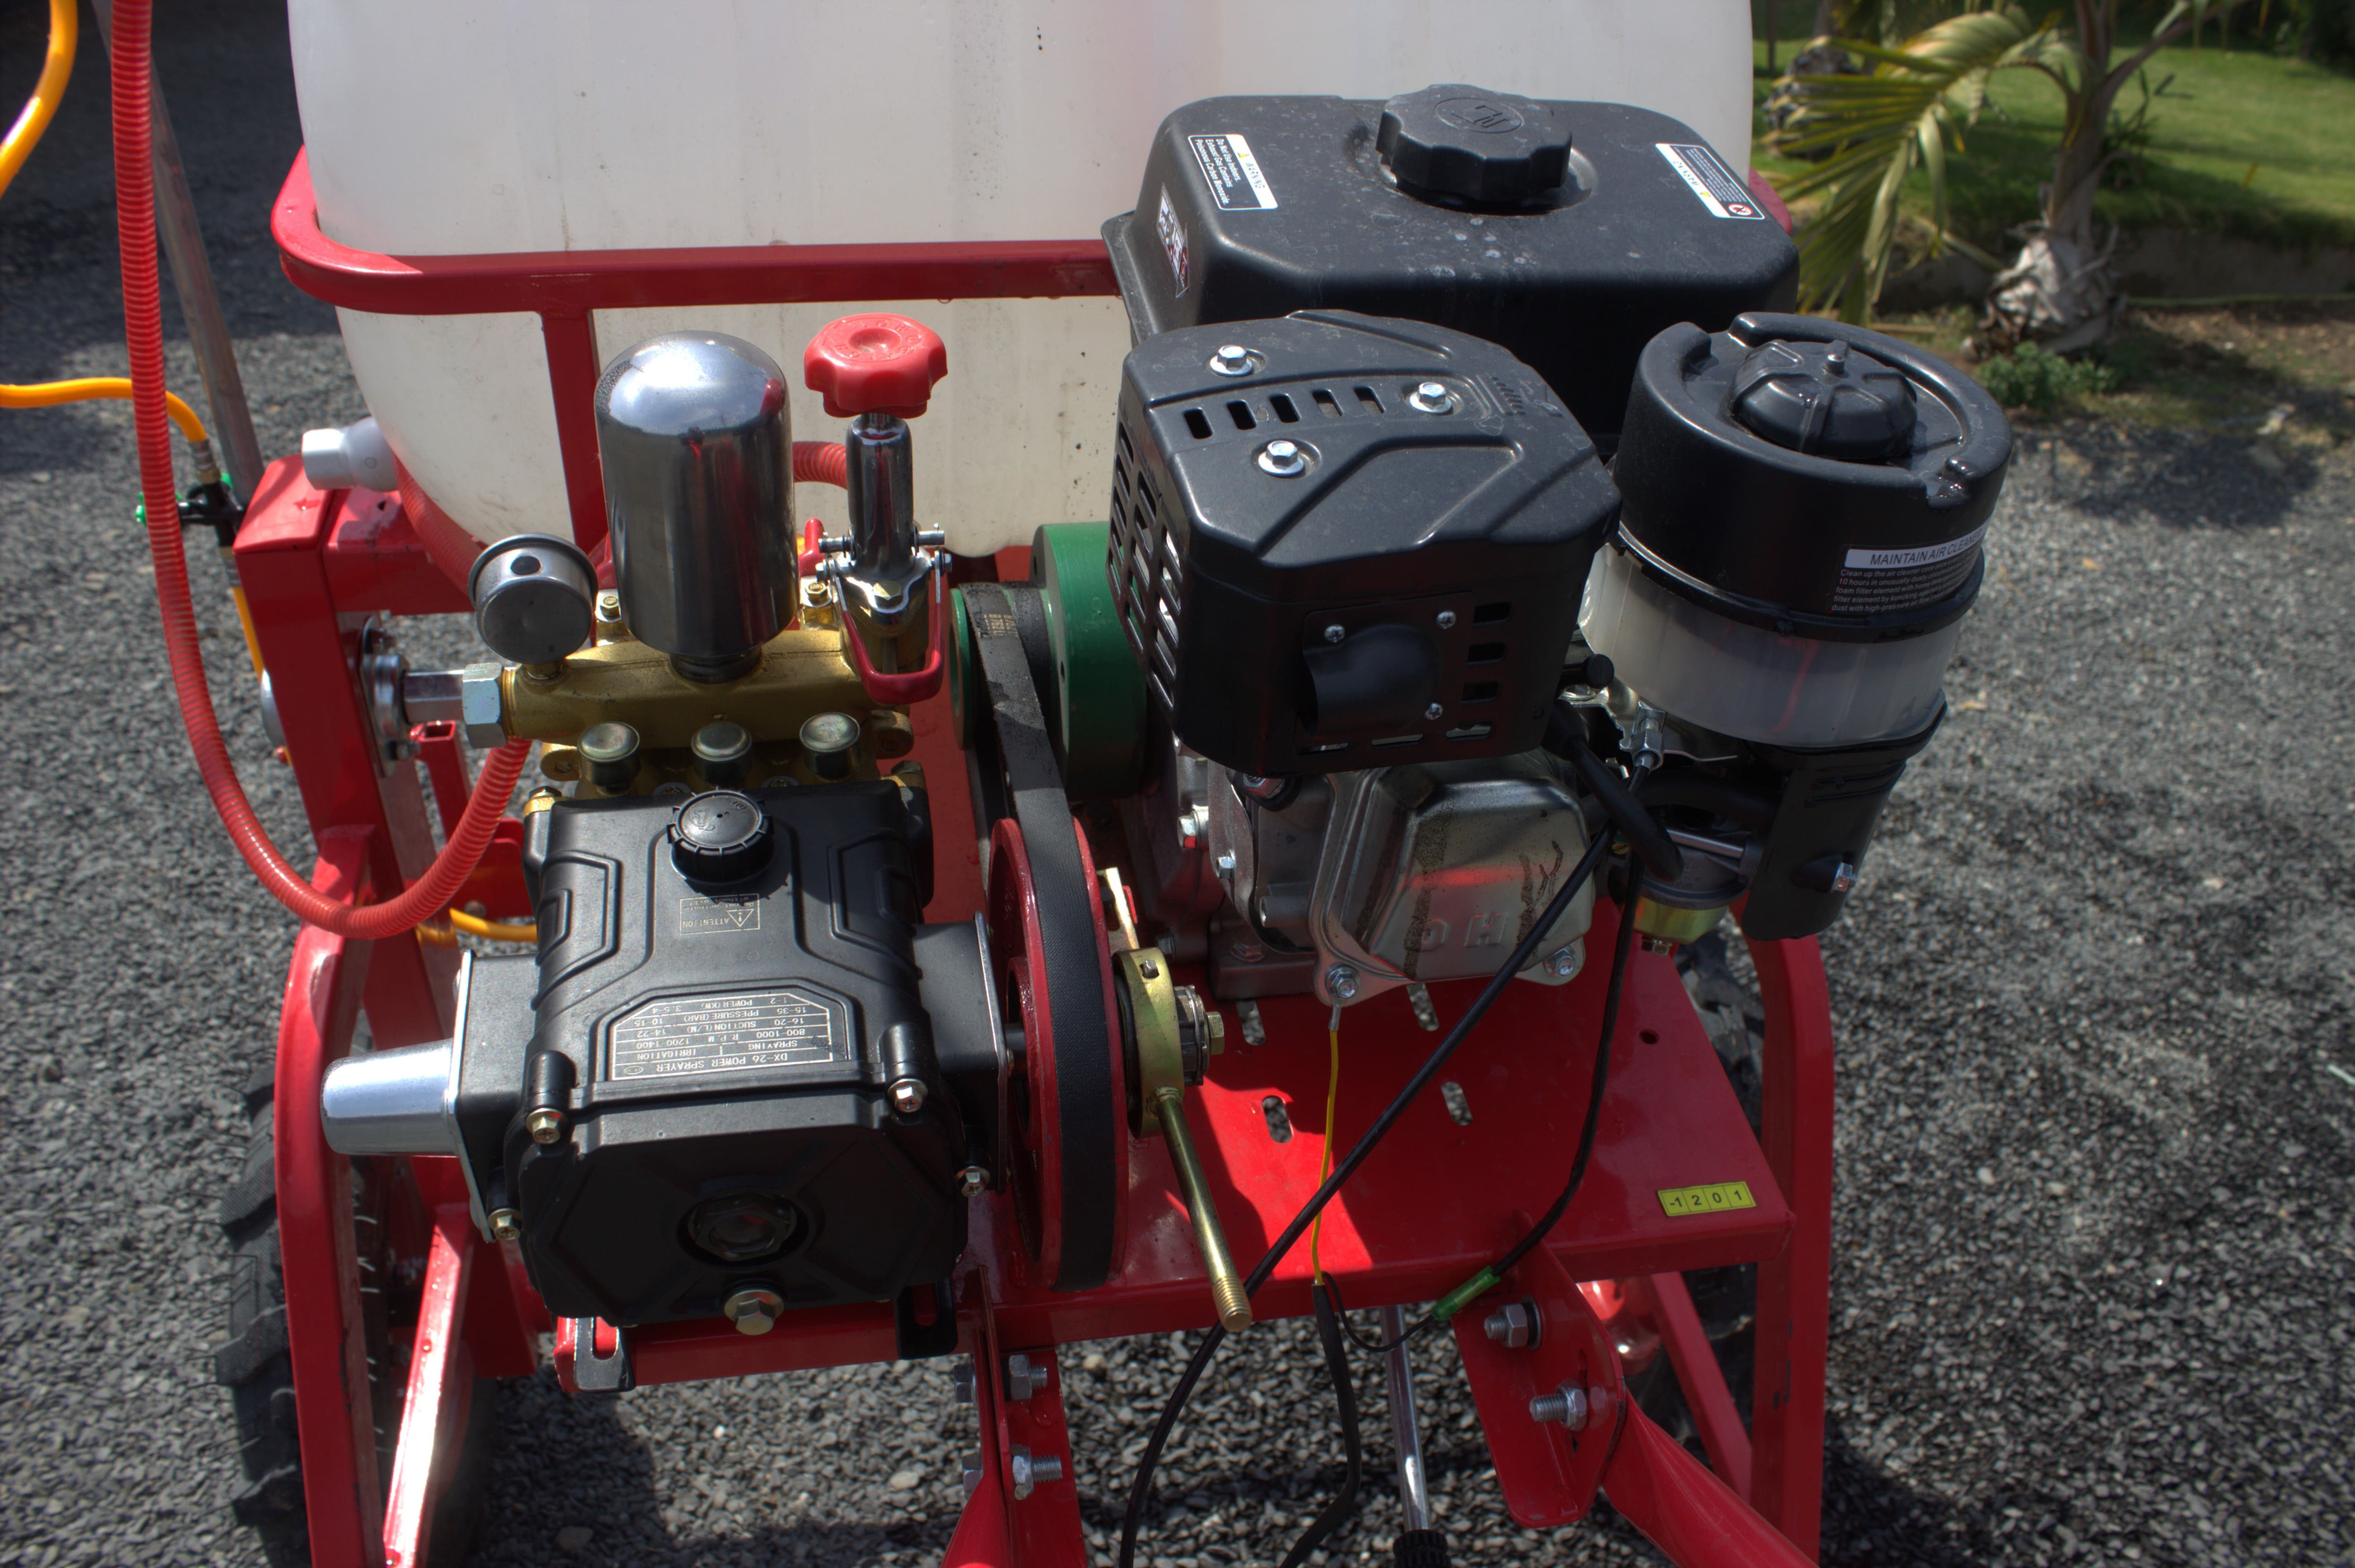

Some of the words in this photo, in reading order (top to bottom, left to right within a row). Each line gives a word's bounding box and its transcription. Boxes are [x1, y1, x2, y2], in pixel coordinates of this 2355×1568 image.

[1205, 139, 1220, 157] Exhaust
[1195, 139, 1211, 163] Poisonous
[1206, 163, 1219, 180] Carbon
[1214, 157, 1223, 166] Gas
[1218, 166, 1234, 188] Contains
[1870, 551, 1929, 565] MAINTAIN
[1928, 547, 1947, 560] AIR
[1947, 528, 1982, 555] CLEANER
[1896, 568, 1920, 576] cleaner
[1879, 578, 1910, 586] unusually
[1865, 601, 1910, 612] high-pressure
[682, 917, 729, 927] ATTENTION
[776, 1006, 807, 1014] 15-35
[634, 1018, 663, 1027] 10-15
[774, 1017, 804, 1026] 16-20
[637, 1028, 666, 1037] 14-22
[756, 1028, 805, 1038] 800-1000
[636, 1038, 689, 1049] 1200-1400
[748, 1040, 797, 1050] SPRAYING
[637, 1048, 696, 1061] IRRIGATION
[752, 1053, 788, 1063] DX-26
[656, 1060, 704, 1072] SPRAYER
[711, 1056, 746, 1067] POWER
